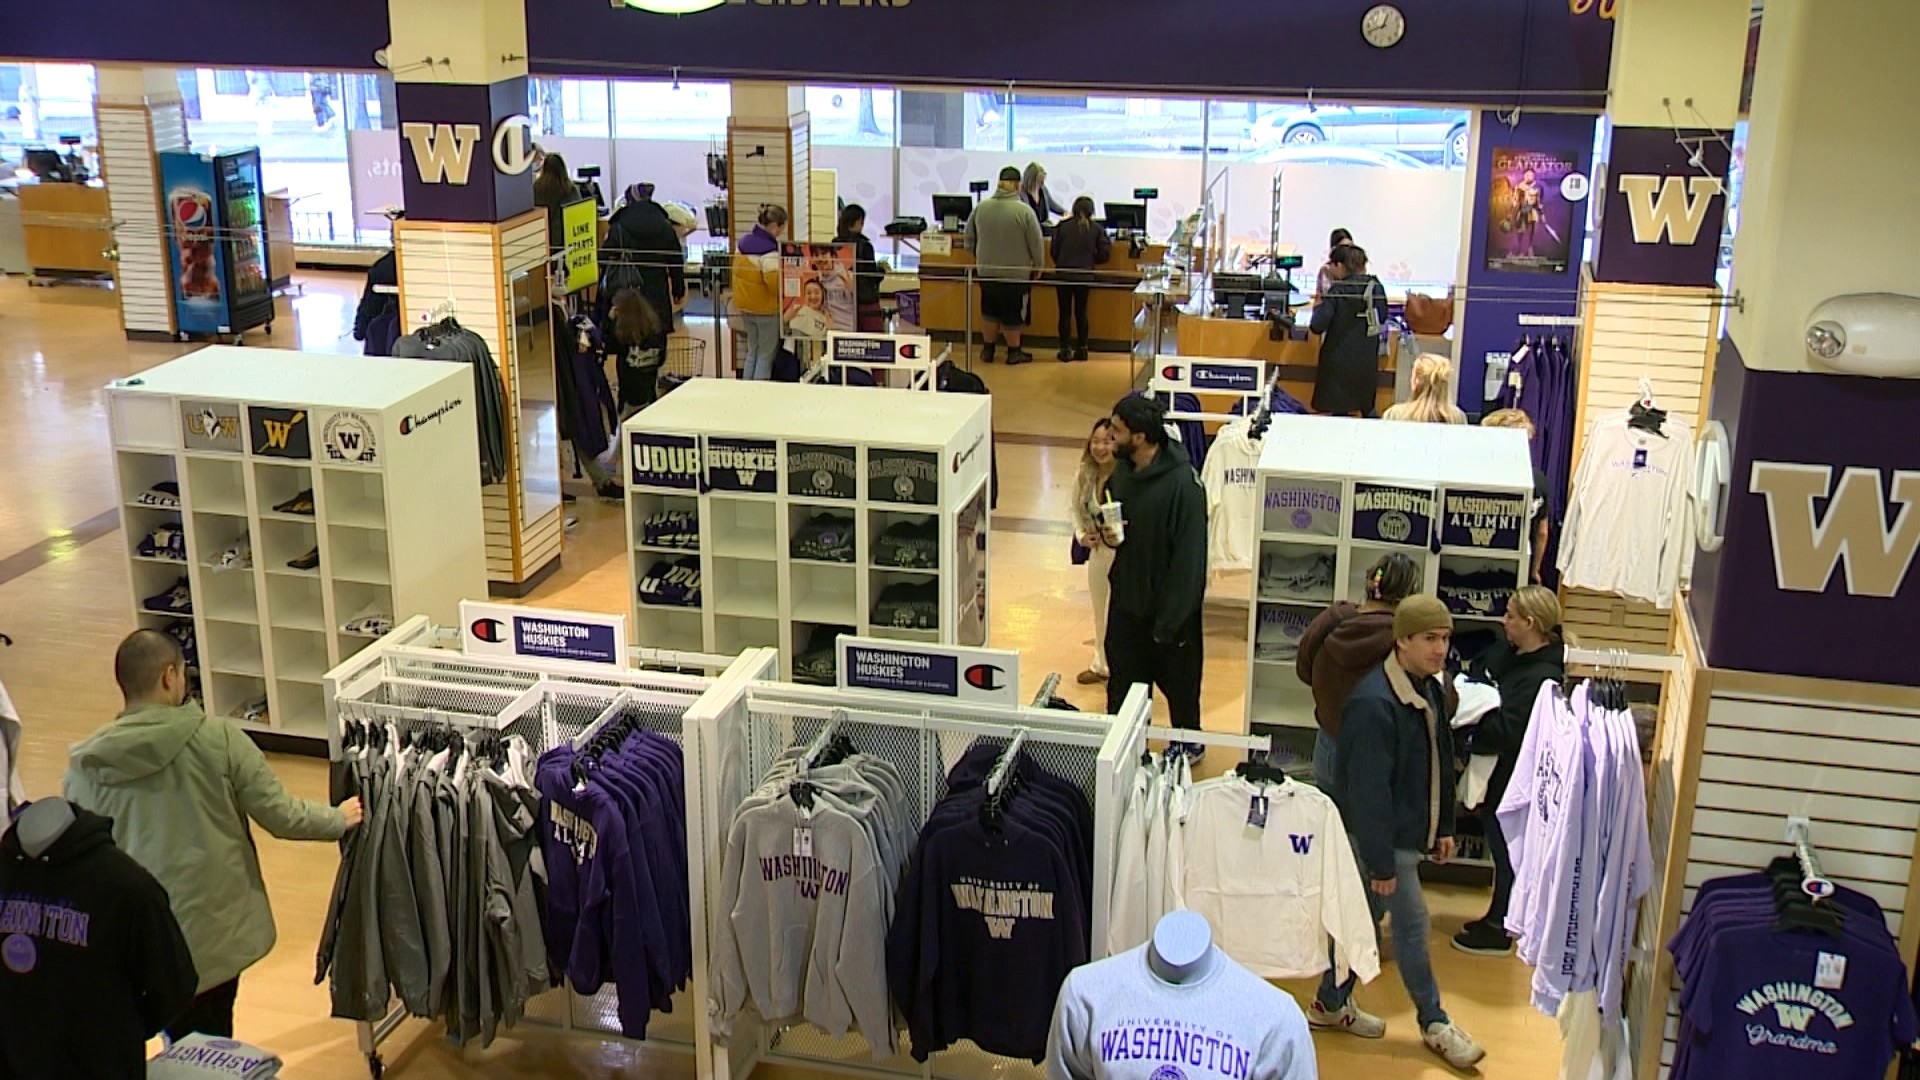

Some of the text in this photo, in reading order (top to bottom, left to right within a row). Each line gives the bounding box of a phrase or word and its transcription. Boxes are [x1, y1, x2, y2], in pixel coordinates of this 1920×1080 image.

[402, 122, 481, 185] W
[1619, 174, 1722, 246] W
[572, 222, 590, 237] LINE
[572, 253, 592, 269] HERE
[1195, 369, 1253, 384] Champion
[400, 398, 463, 439] Champion
[263, 418, 293, 450] W
[338, 431, 361, 450] W
[633, 443, 701, 474] UDUB
[709, 449, 777, 471] HUSKIE
[1264, 488, 1341, 514] WASHINGTON
[1355, 491, 1437, 519] WASHINGTON
[1447, 496, 1525, 518] WASHINGTON
[1450, 513, 1517, 530] ALUMNI
[1749, 460, 1920, 599] W
[520, 620, 589, 640] WASHINGTON
[522, 633, 567, 648] HUSKIES
[855, 650, 931, 670] WASHINGTON
[856, 662, 905, 679] HUSKIES
[1288, 833, 1315, 855] W
[983, 915, 1016, 939] W
[1735, 980, 1856, 1032] WASHINGTON
[1774, 1001, 1816, 1032] W
[1116, 1017, 1234, 1041] UNIVERSITY OF
[1744, 1022, 1838, 1055] Grandma
[1100, 1027, 1251, 1080] WASHINGTON
